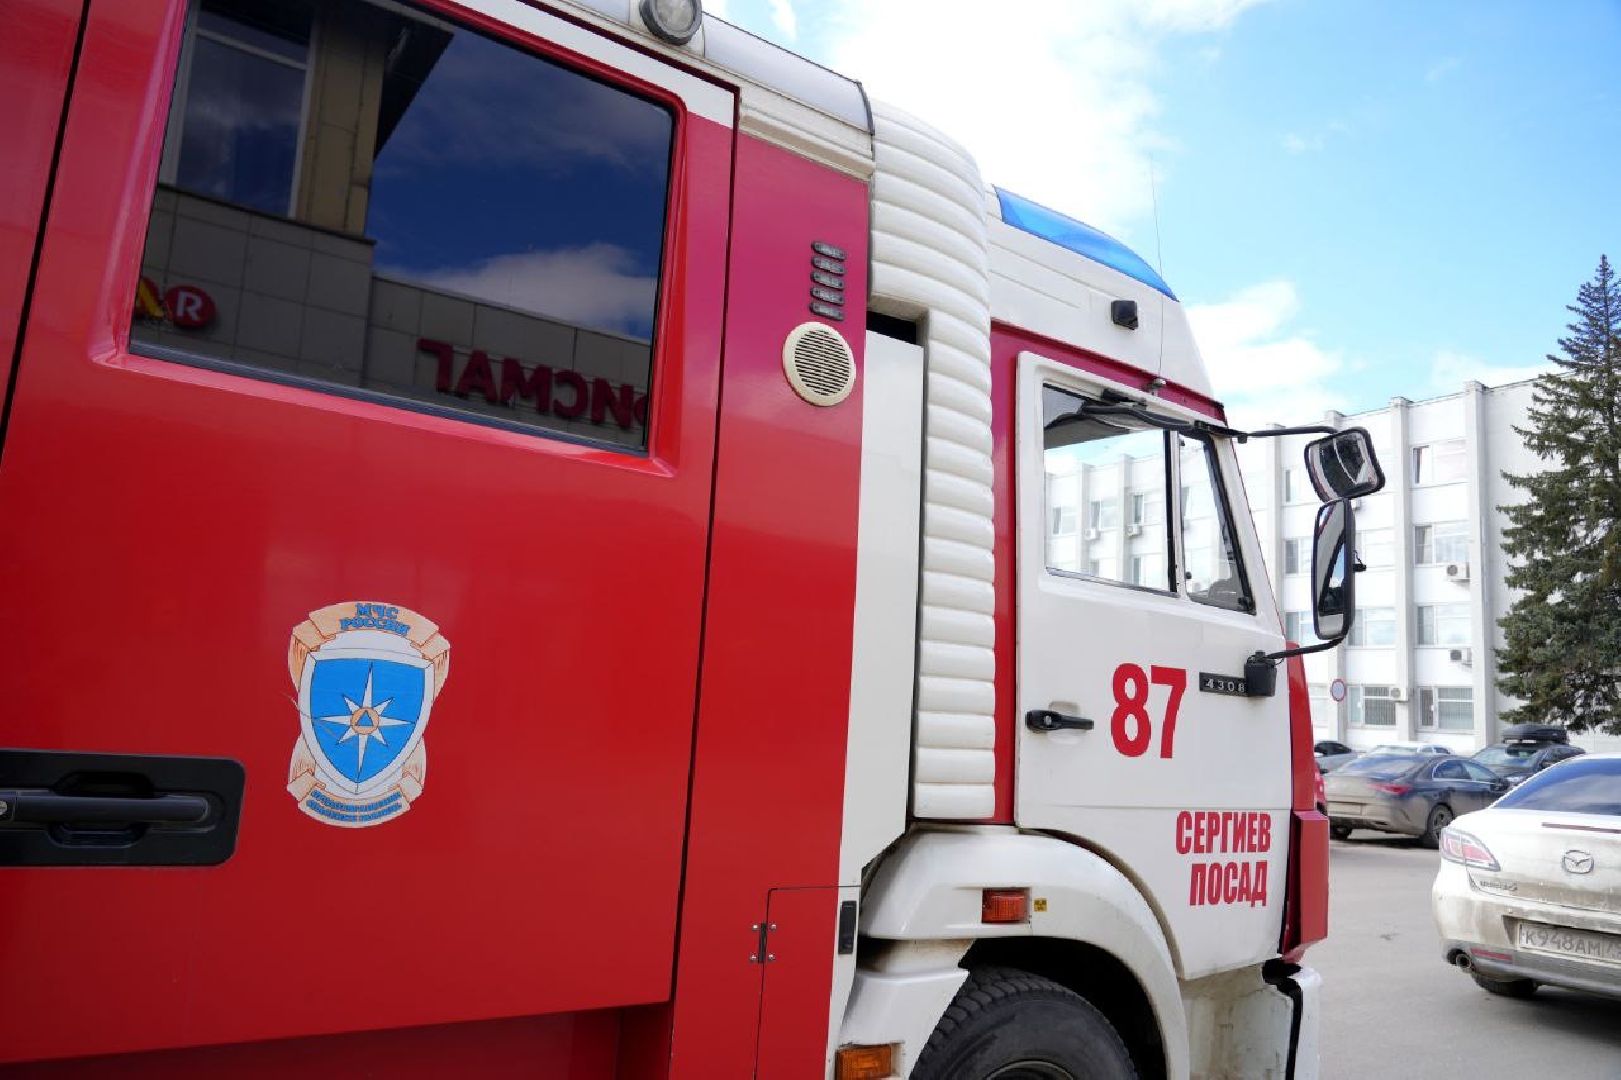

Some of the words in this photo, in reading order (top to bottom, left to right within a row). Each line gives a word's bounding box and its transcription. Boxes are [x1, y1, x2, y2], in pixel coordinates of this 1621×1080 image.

[355, 602, 399, 619] МЧС
[1111, 662, 1187, 759] 87
[1175, 810, 1271, 855] СЕРГИЕВ
[1189, 860, 1268, 907] ПОСАД
